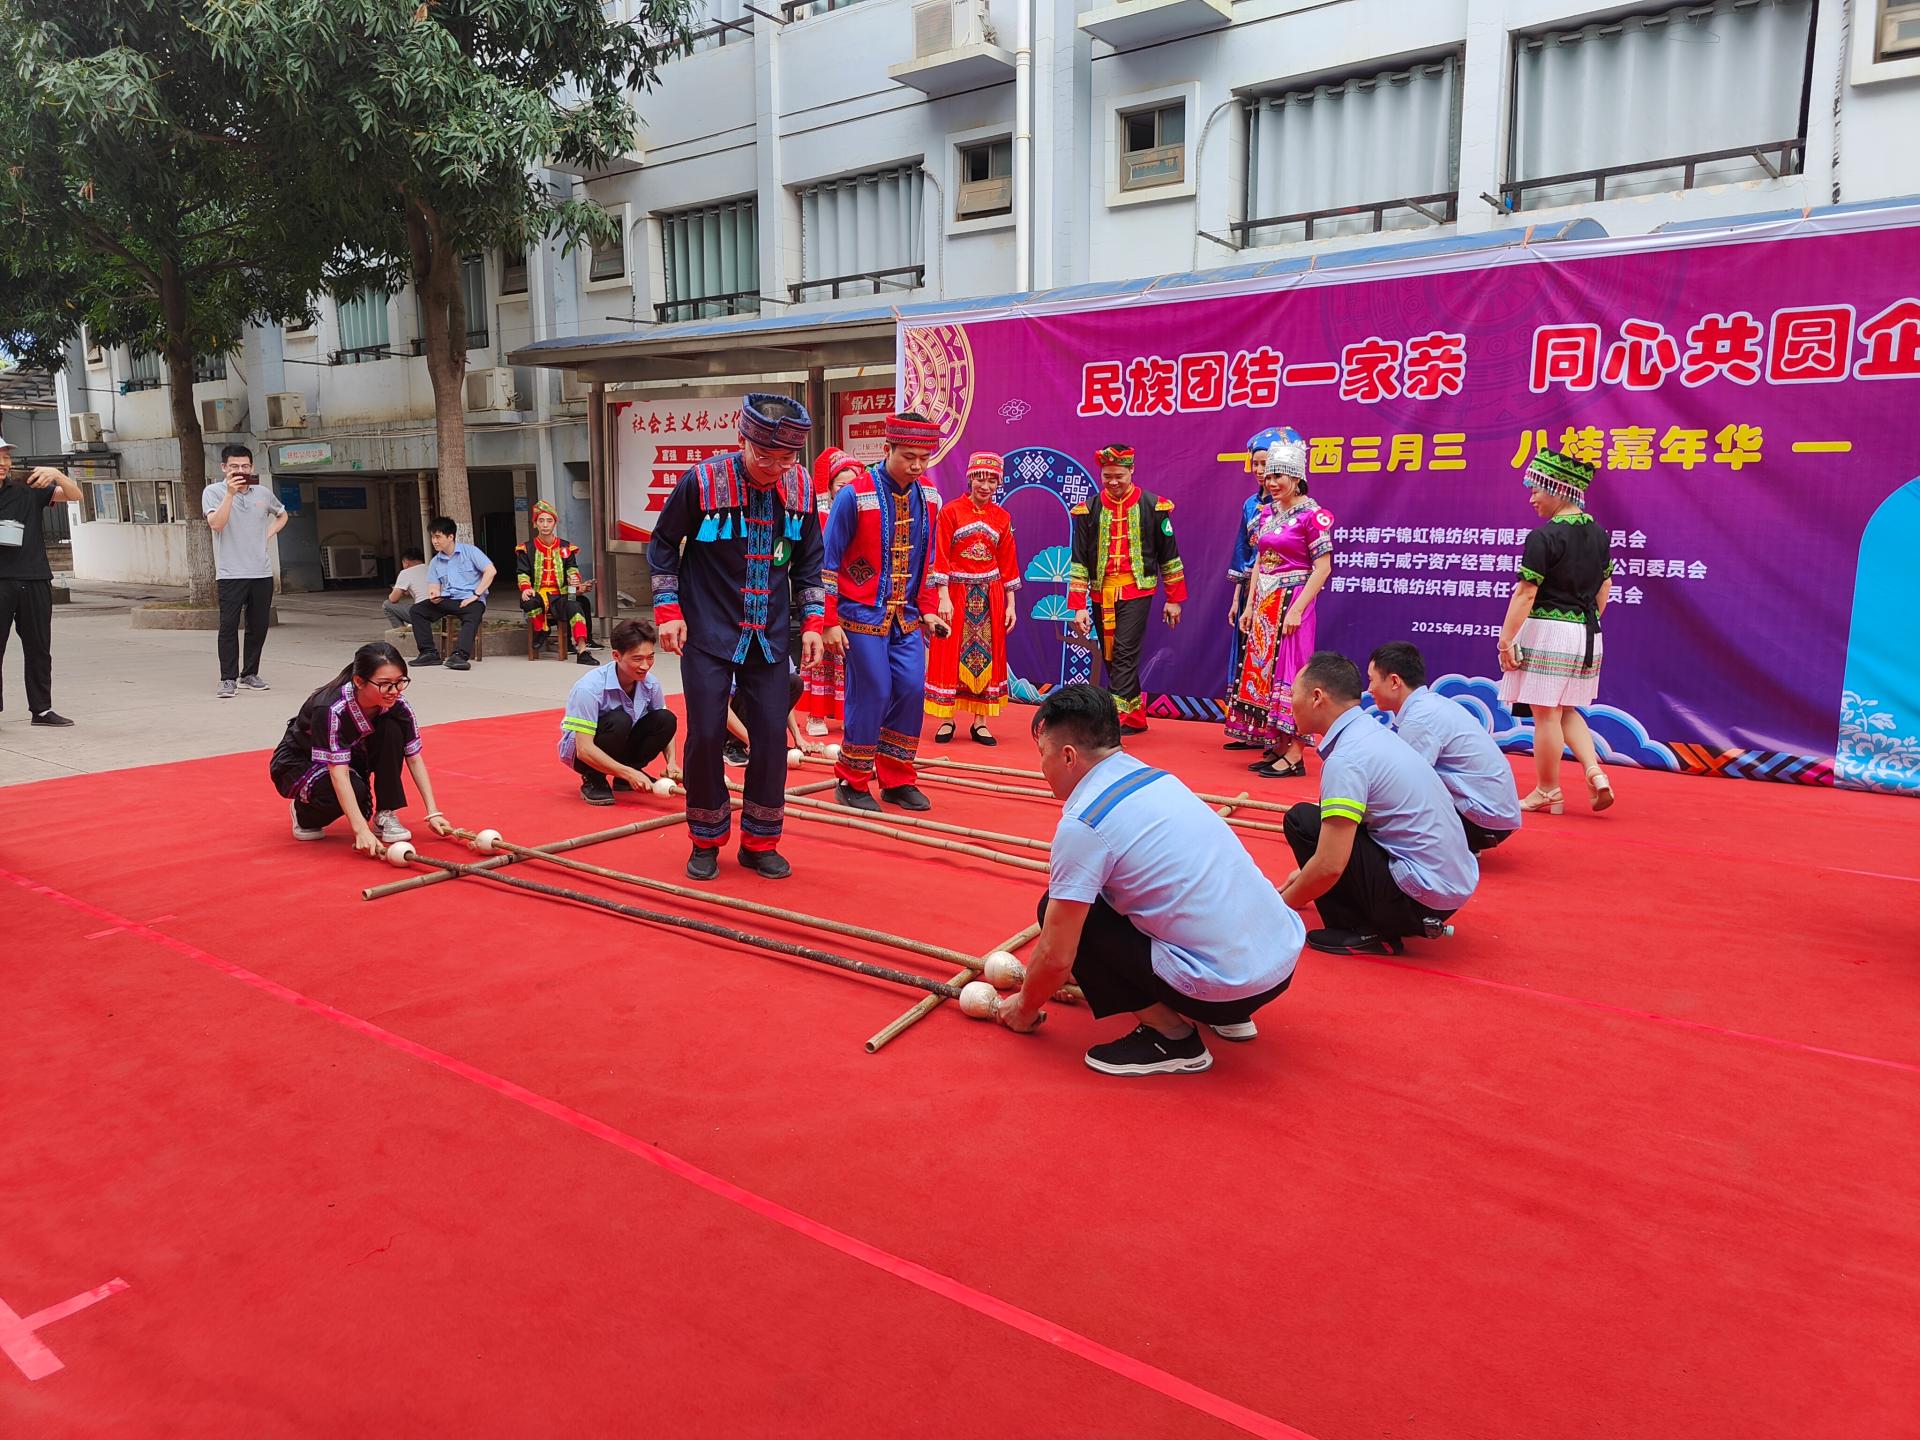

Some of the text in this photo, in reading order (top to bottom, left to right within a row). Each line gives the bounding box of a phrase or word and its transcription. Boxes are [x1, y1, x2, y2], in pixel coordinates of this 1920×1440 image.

[1078, 332, 1465, 417] 民族团结一家亲
[662, 450, 677, 461] 富强
[687, 449, 702, 461] 民主
[1308, 423, 1764, 473] 西三月三 八桂嘉年华
[663, 473, 677, 484] 自由
[563, 547, 568, 557] 1
[774, 541, 784, 561] 4
[1411, 621, 1502, 637] 2025年4月23日
